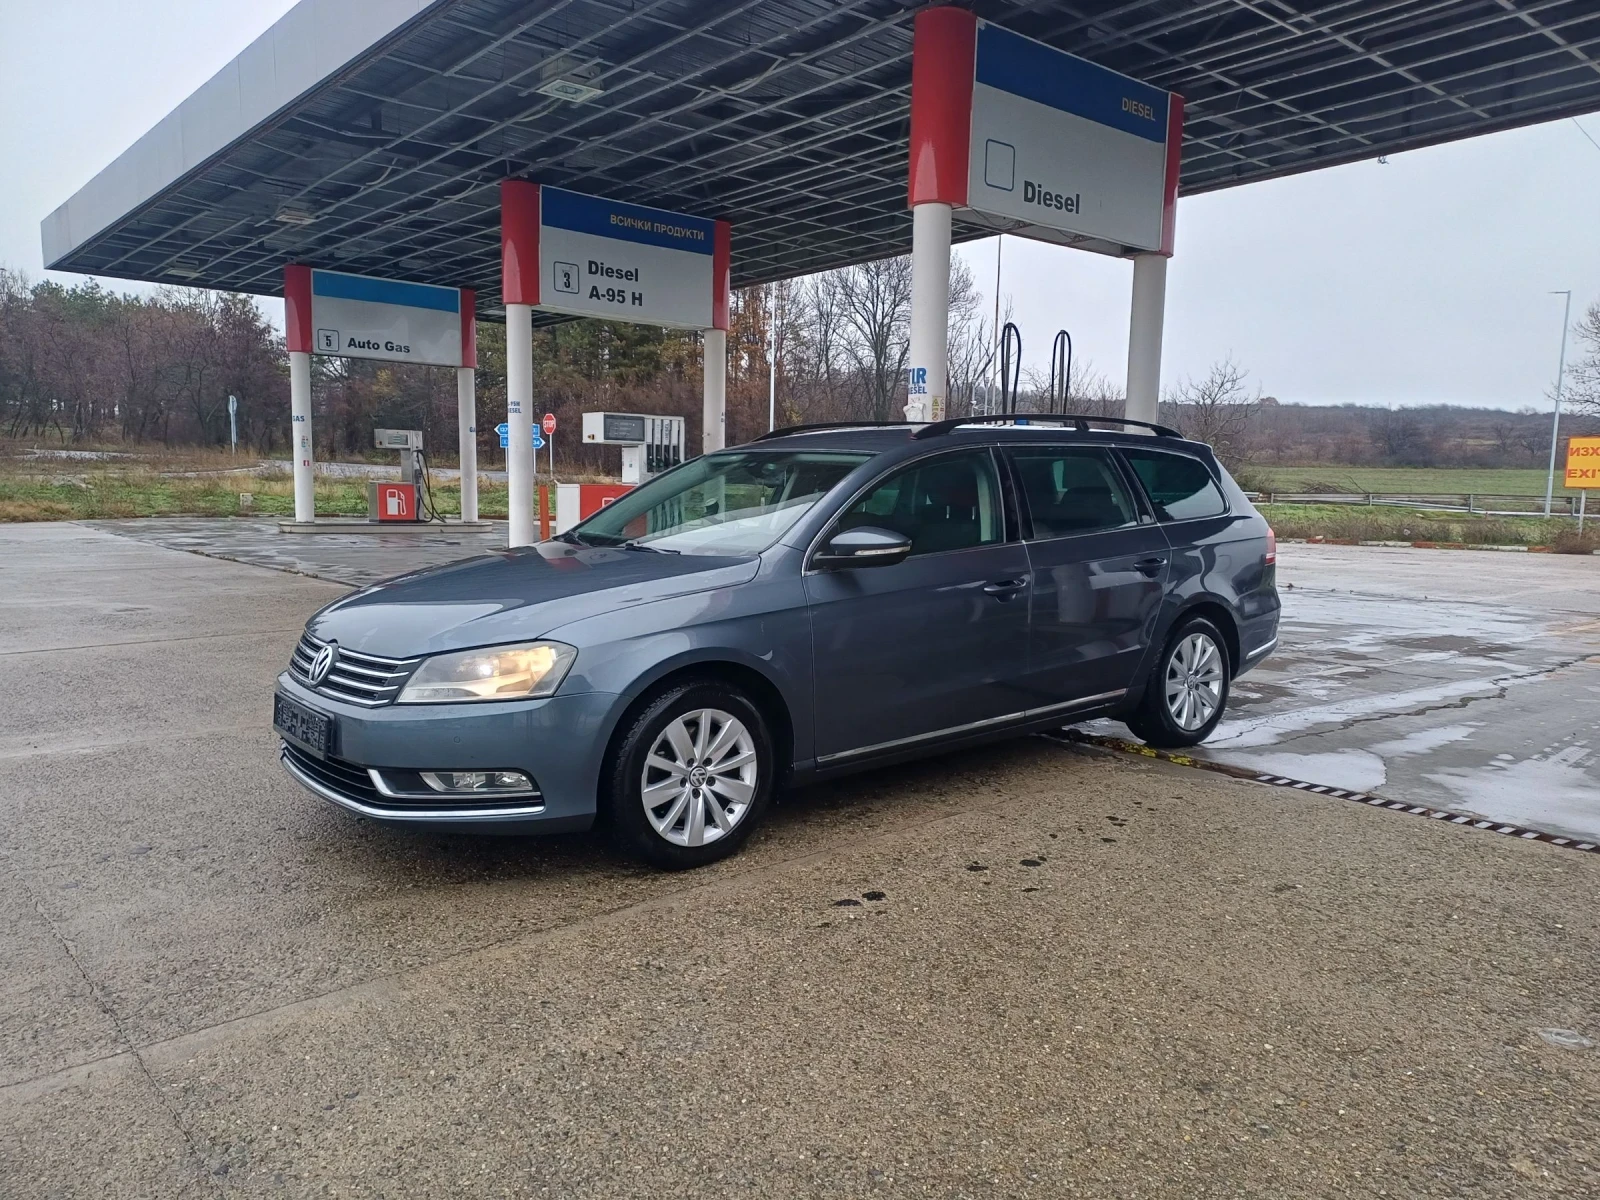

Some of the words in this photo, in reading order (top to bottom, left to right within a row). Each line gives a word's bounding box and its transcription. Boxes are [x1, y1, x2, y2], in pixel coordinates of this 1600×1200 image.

[1121, 97, 1156, 121] DIESEL
[1023, 180, 1080, 214] Diesel
[610, 214, 651, 231] ВСИЧКИ
[653, 223, 704, 240] ПРОДУКТИ
[563, 272, 571, 289] 3
[588, 260, 639, 282] Diesel
[589, 285, 626, 304] A-95
[631, 292, 643, 306] H
[325, 335, 332, 347] 5
[347, 337, 380, 350] Auto
[384, 341, 411, 354] Gas
[907, 367, 927, 385] TIR
[543, 420, 555, 428] STOP
